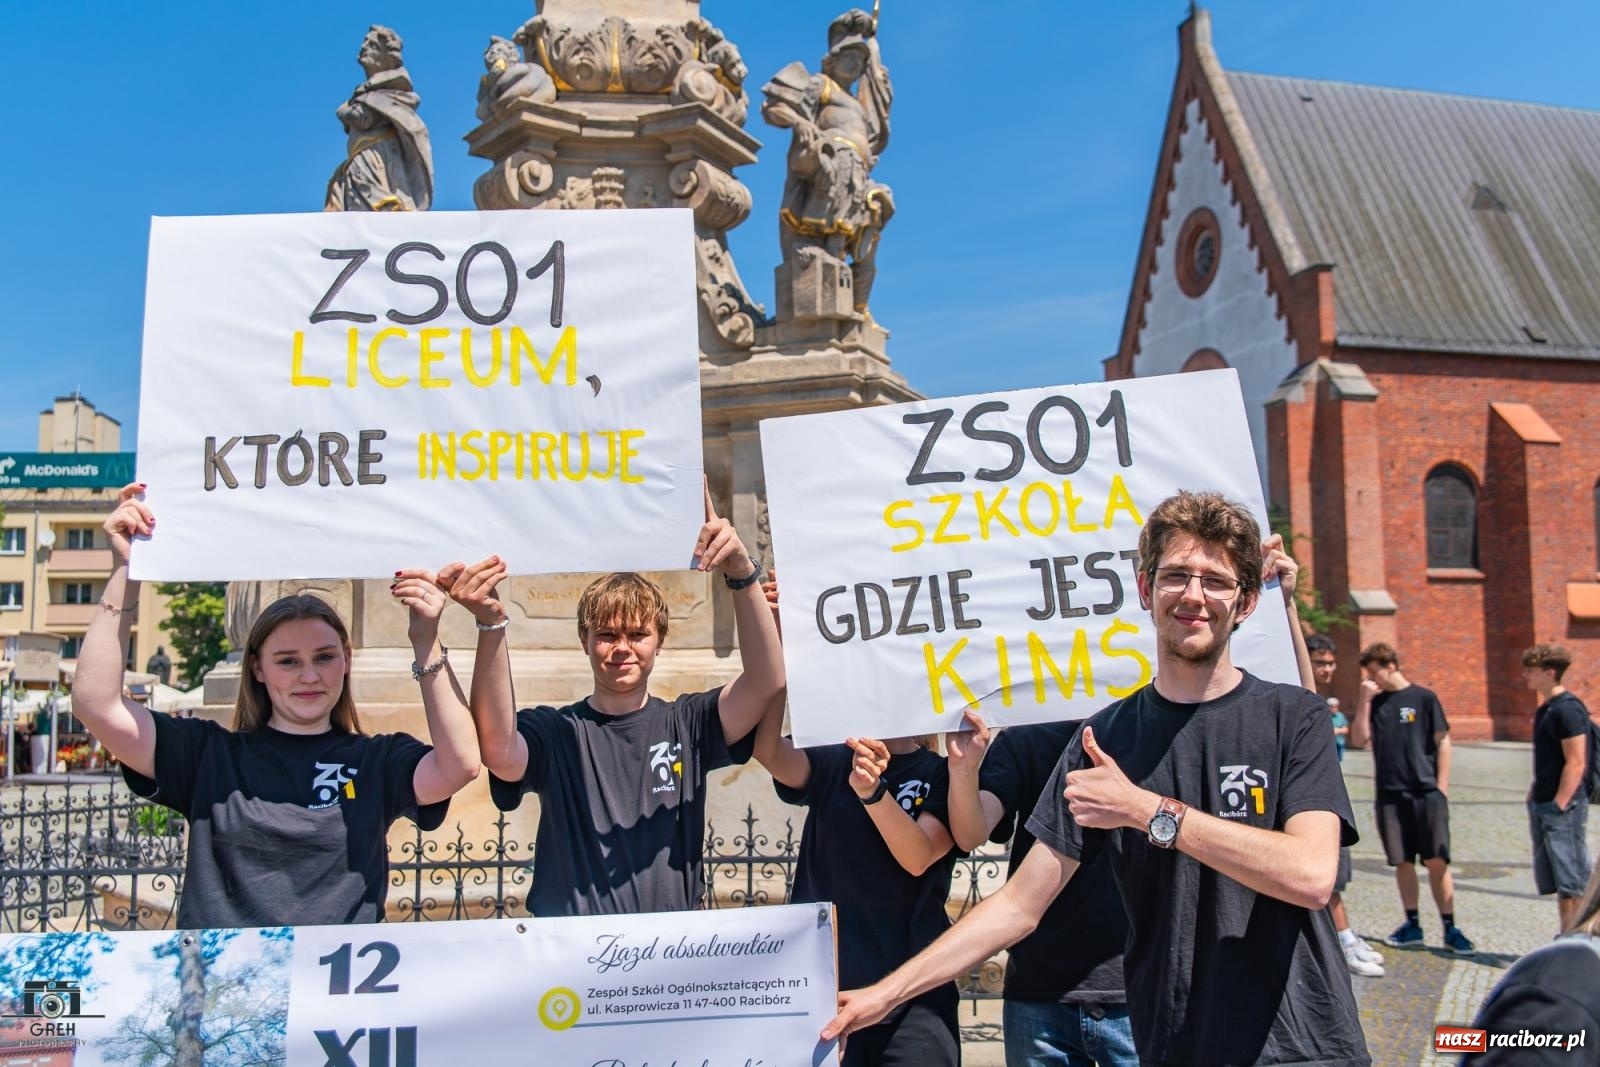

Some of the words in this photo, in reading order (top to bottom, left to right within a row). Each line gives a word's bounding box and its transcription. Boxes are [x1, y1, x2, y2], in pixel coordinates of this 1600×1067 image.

[291, 325, 602, 398] LICEUM,
[24, 464, 99, 477] McDonald's
[204, 429, 387, 491] KTÓRE
[418, 430, 646, 483] INSPIRUJE
[882, 473, 1144, 553] SZKOŁA
[815, 568, 982, 645] GDZIE
[319, 940, 401, 995] 12
[587, 933, 661, 974] Zjazd
[663, 932, 785, 960] absolwentów
[587, 986, 628, 999] Zespół
[631, 984, 664, 996] Szkół
[667, 977, 785, 995] Ogólnokształcących
[788, 979, 801, 988] nr
[803, 977, 809, 987] 1
[587, 1004, 602, 1015] ul.
[605, 1001, 680, 1015] Kasprowicza
[682, 999, 692, 1009] 11
[694, 996, 737, 1009] 47-400
[739, 994, 791, 1006] Racibórz
